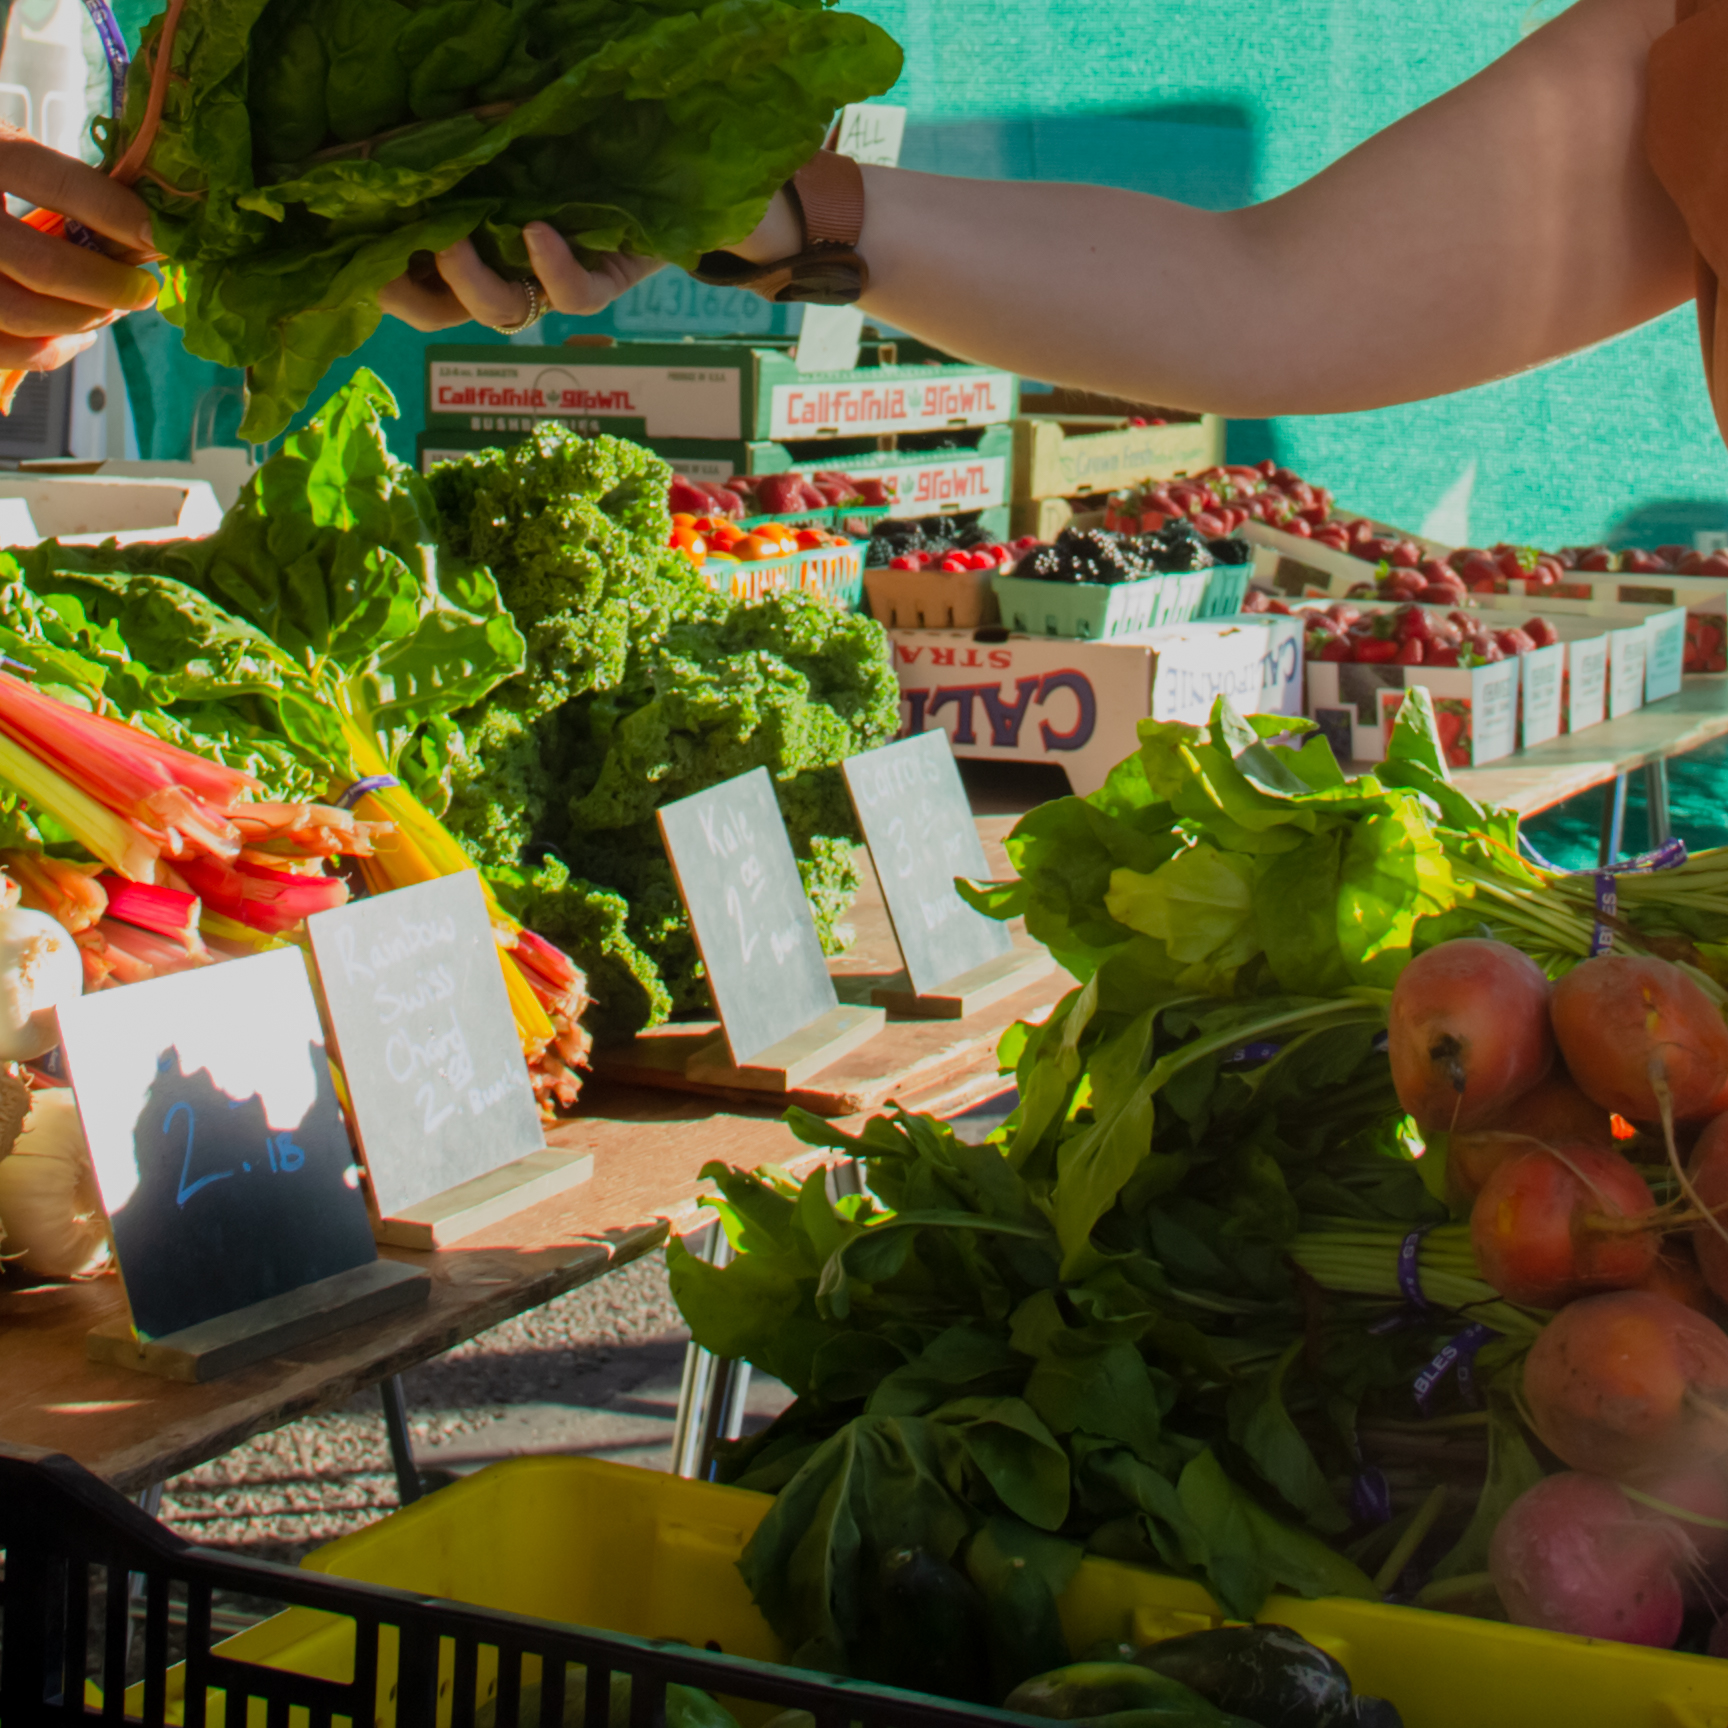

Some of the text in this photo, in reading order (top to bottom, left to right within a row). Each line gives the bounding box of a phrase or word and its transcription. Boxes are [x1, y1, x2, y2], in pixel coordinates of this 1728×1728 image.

[843, 113, 885, 150] ALL
[438, 385, 635, 411] California grown
[786, 382, 1000, 426] California grown
[915, 465, 994, 503] grown
[694, 804, 754, 860] Kale
[334, 915, 457, 986] Rainbow
[373, 963, 455, 1024] Swiss
[385, 1006, 471, 1083] Chard
